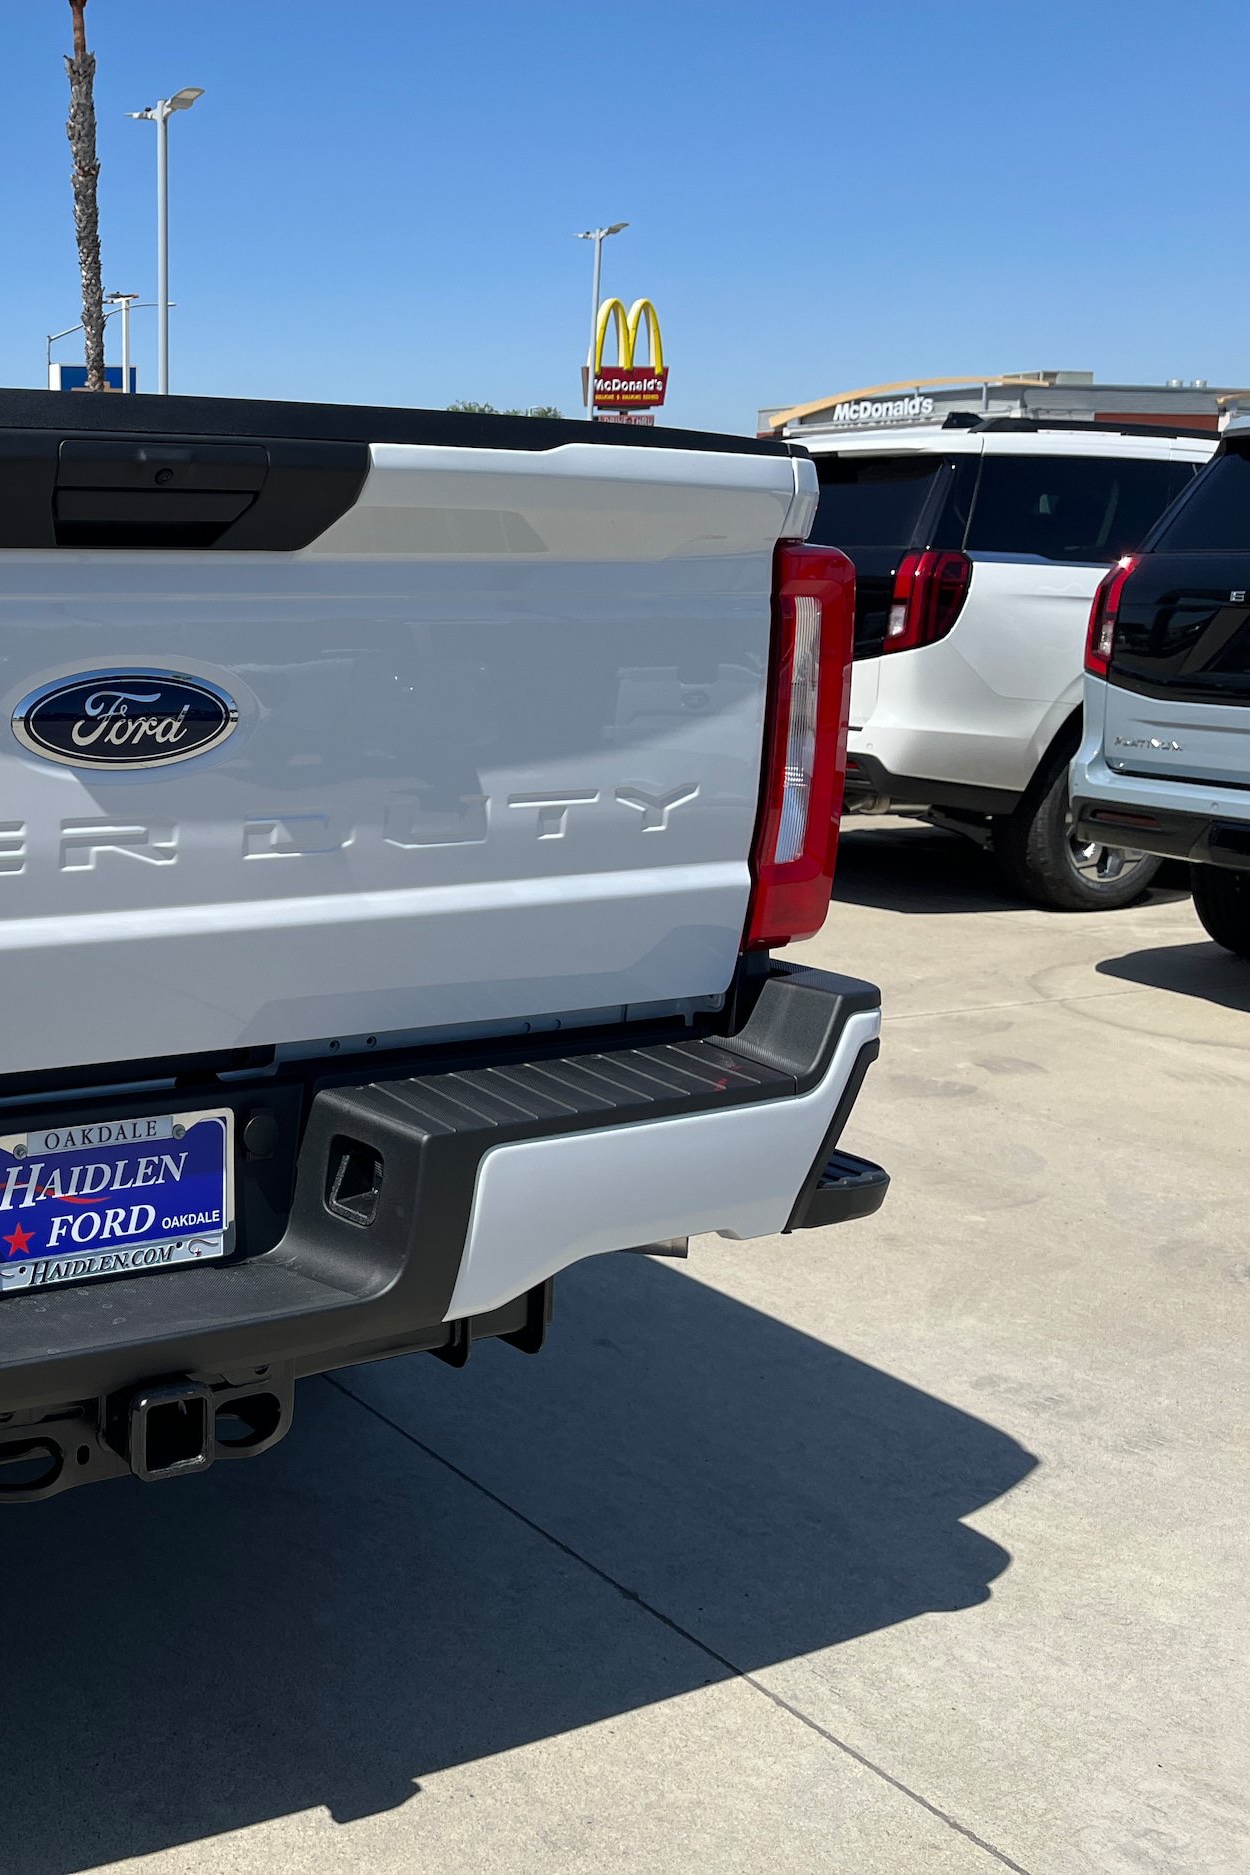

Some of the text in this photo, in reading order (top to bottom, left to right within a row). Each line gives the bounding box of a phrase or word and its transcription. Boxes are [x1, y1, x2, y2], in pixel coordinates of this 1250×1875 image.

[593, 378, 663, 392] McDonald's
[833, 395, 934, 421] McDonald's
[71, 691, 190, 746] Ford
[242, 782, 700, 860] DUTY
[44, 1120, 158, 1150] OAKDALE
[46, 1204, 221, 1248] FORD OAKDALE
[28, 1244, 176, 1286] HAIDLEN.COM
